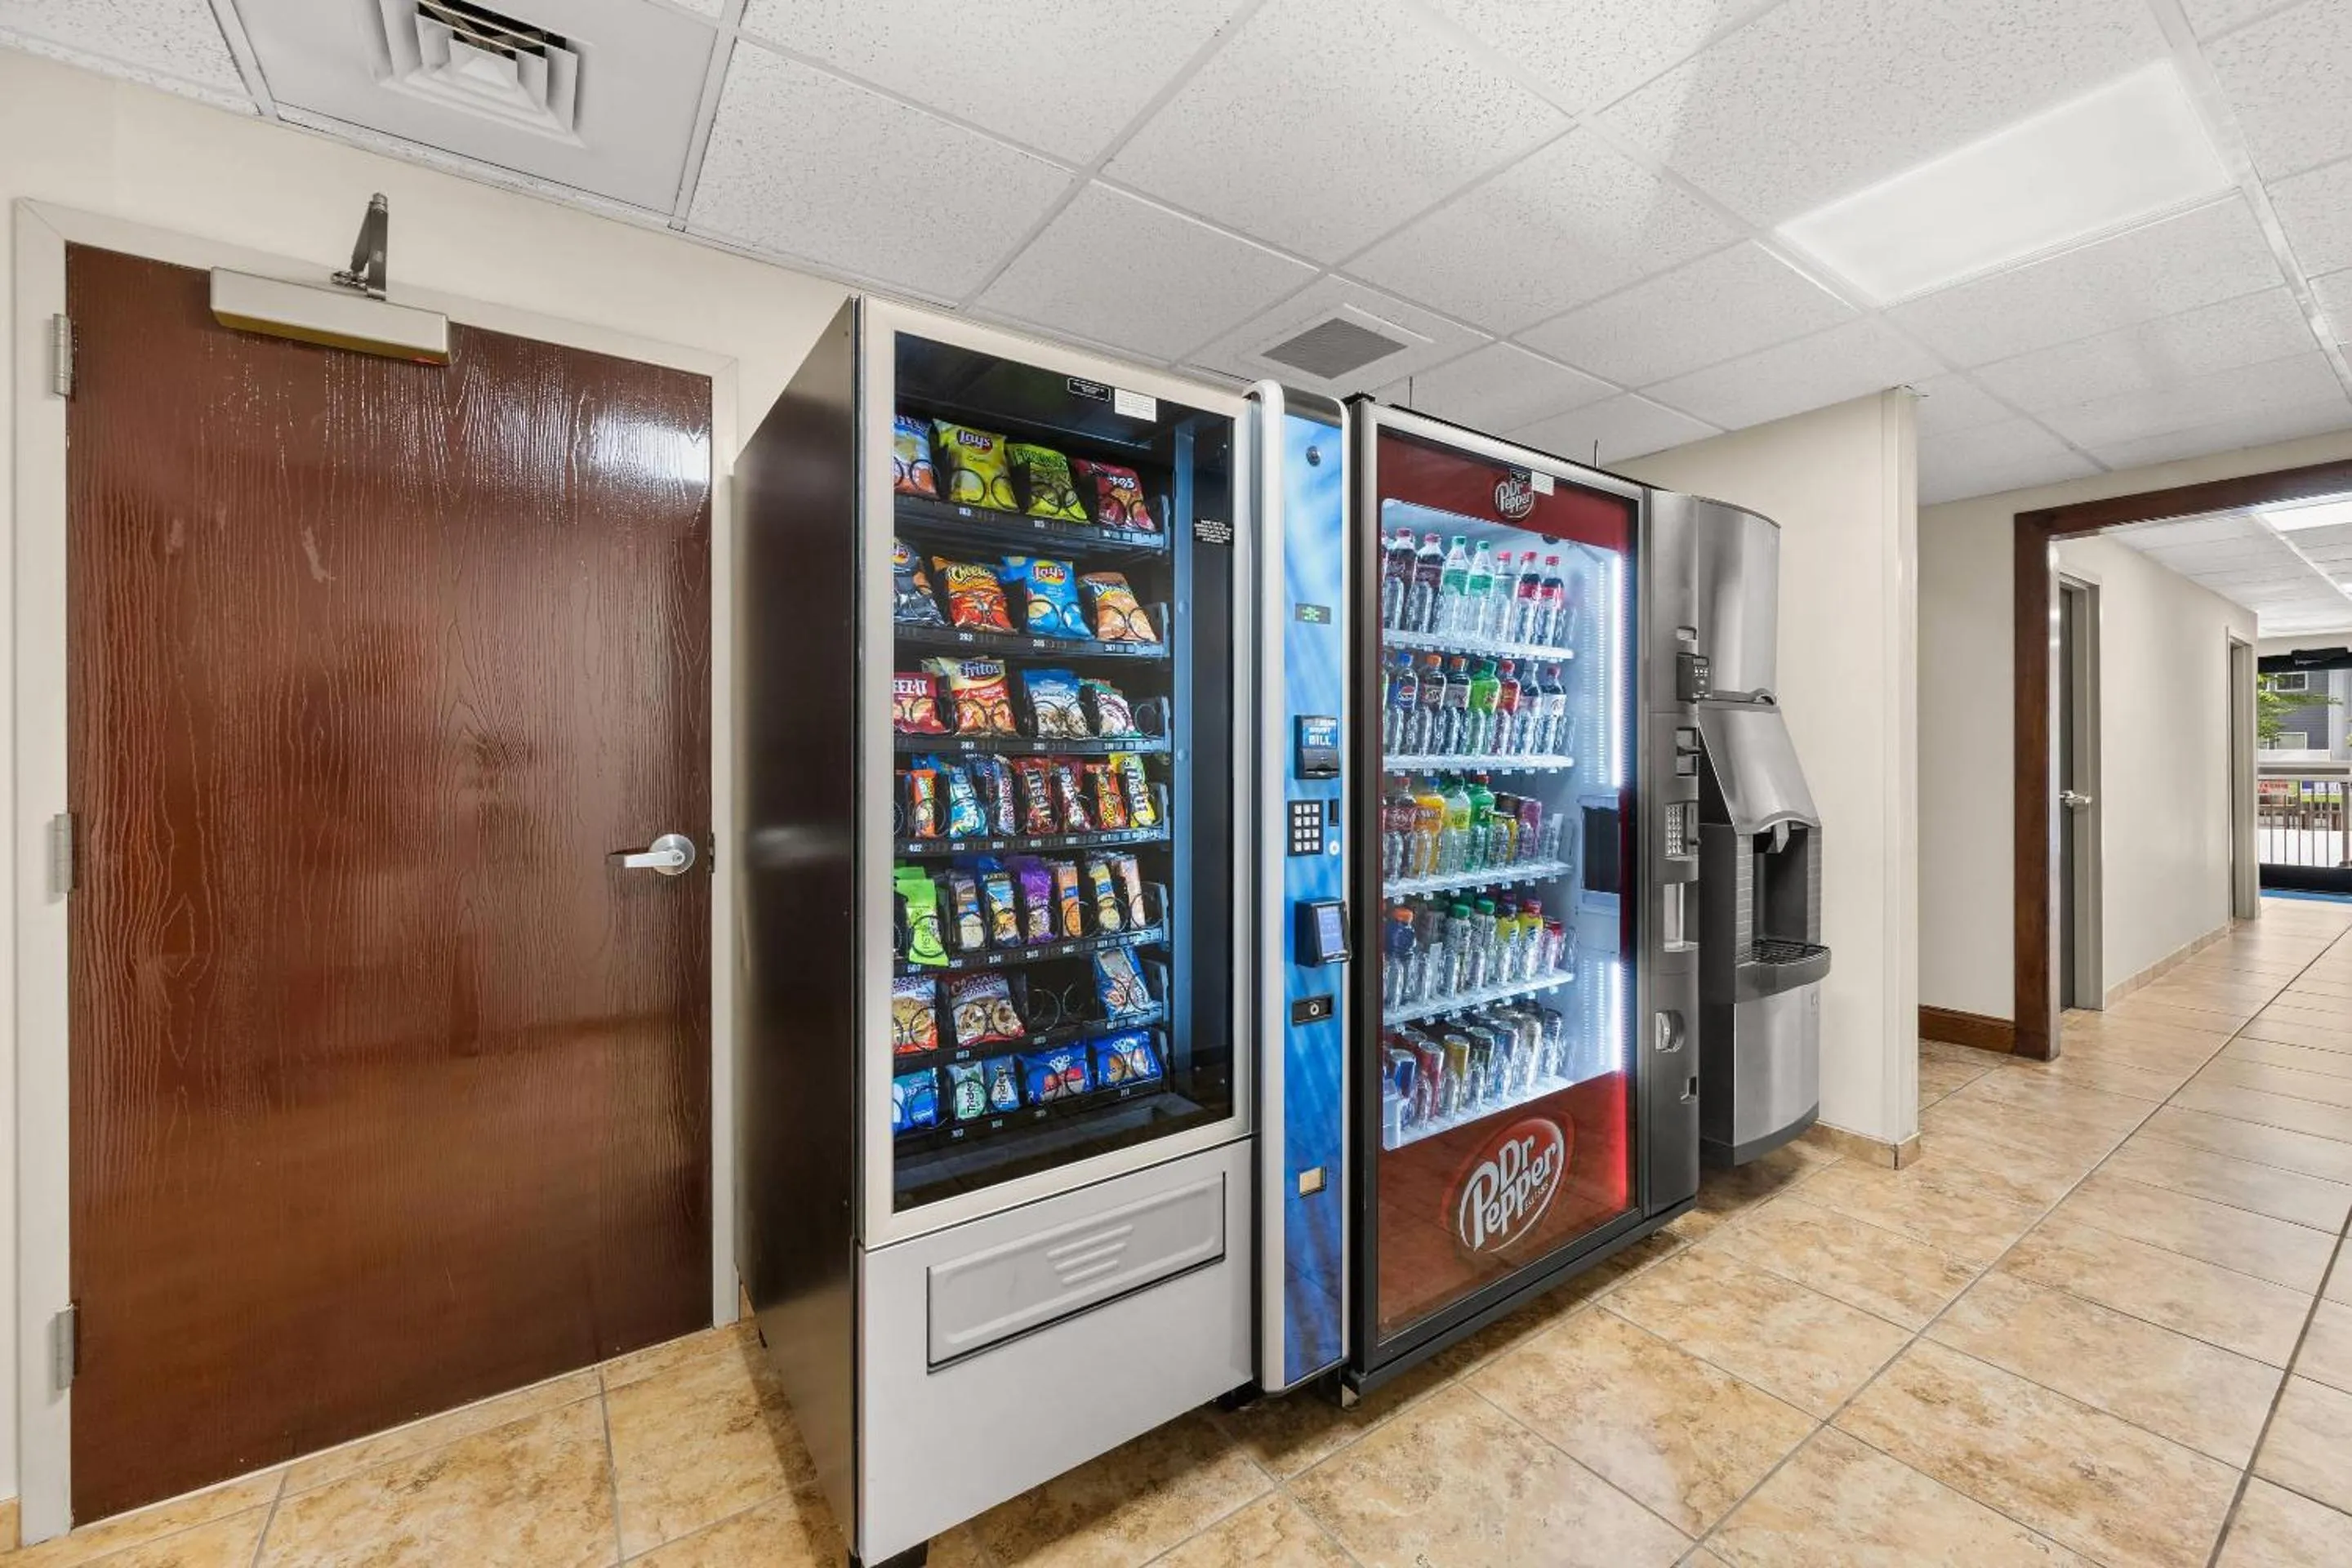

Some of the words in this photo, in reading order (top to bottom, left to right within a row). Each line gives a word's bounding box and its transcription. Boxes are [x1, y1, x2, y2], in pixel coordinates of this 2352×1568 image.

[1496, 481, 1531, 514] Pepper
[1033, 564, 1065, 581] Lay's
[959, 662, 1000, 679] Fritos
[1308, 735, 1332, 746] BILL
[1499, 1135, 1535, 1194] Dr
[1459, 1143, 1557, 1252] Pepper
